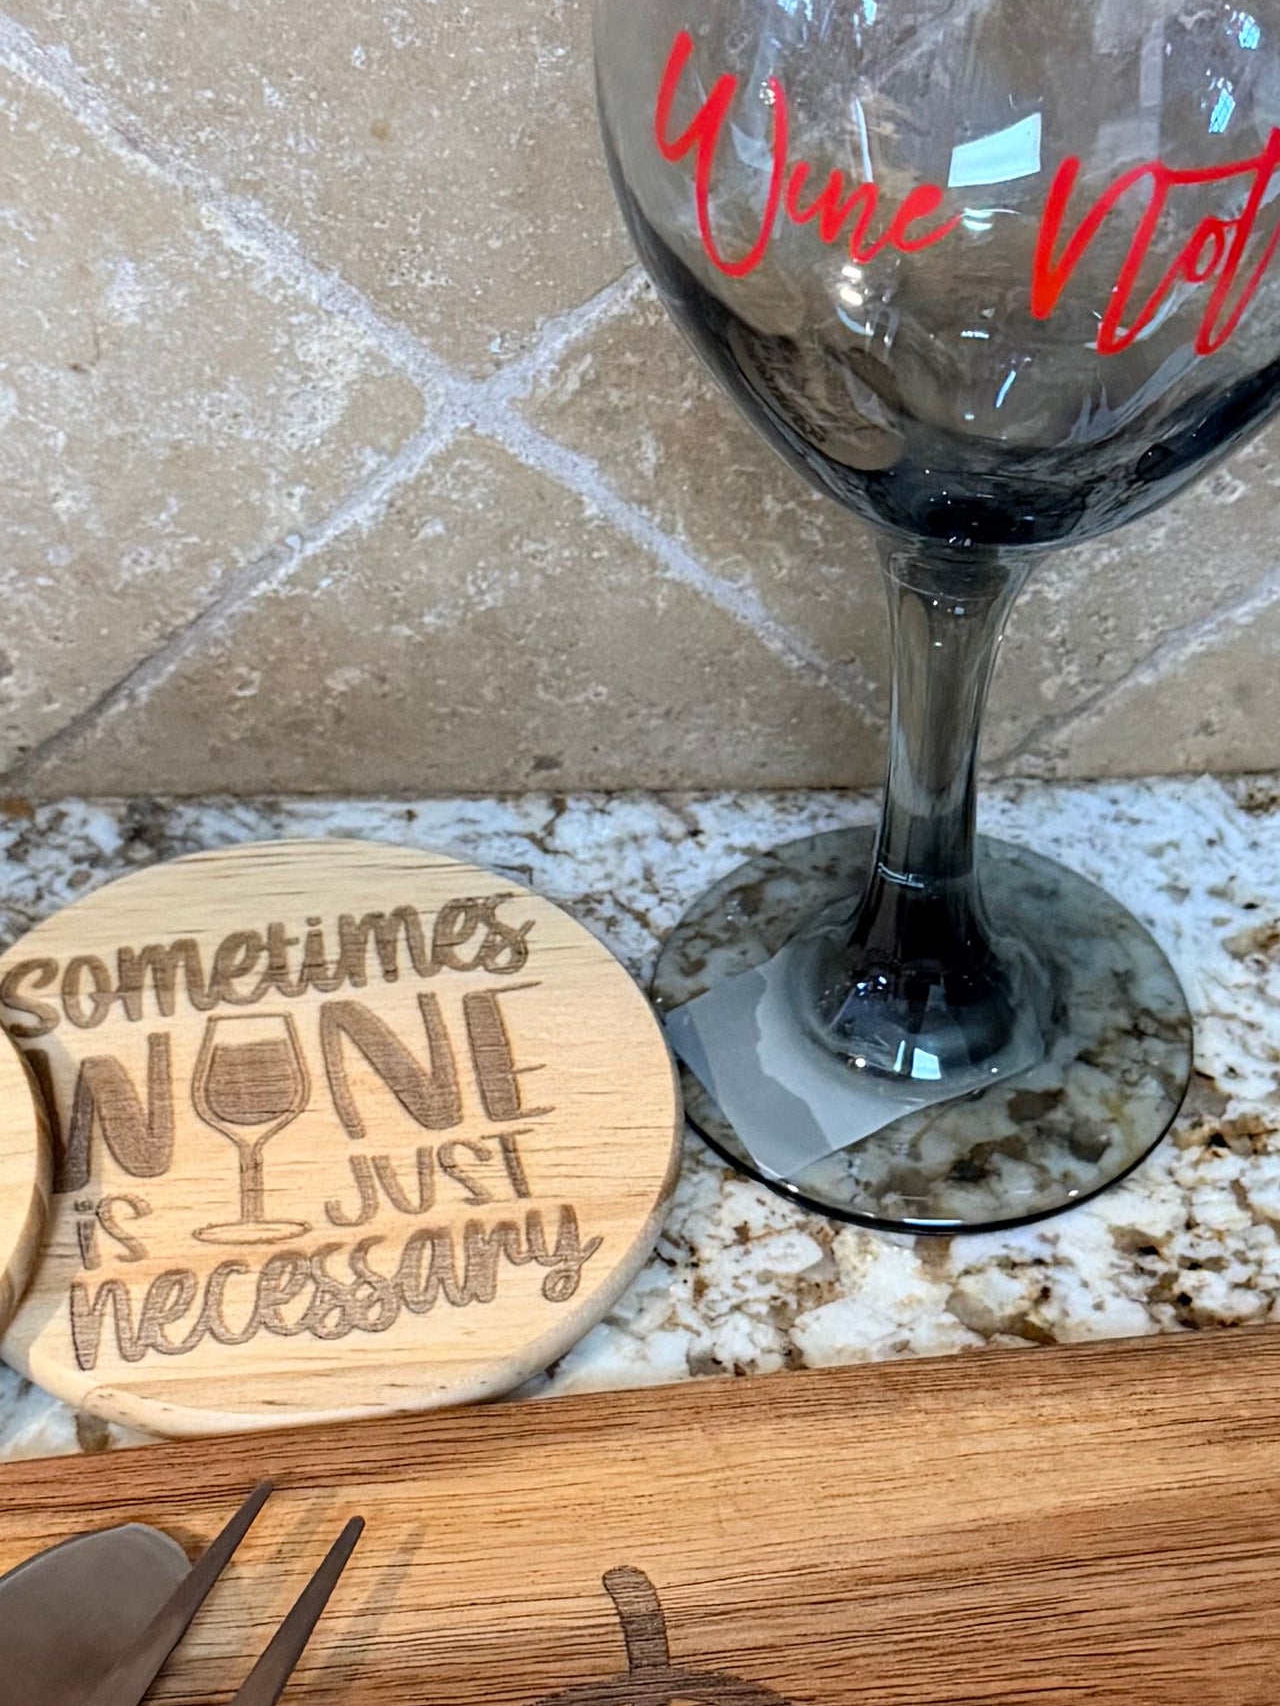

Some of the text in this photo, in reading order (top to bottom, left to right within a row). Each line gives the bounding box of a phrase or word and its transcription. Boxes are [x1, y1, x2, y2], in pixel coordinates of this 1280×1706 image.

[654, 31, 962, 277] Wine
[324, 1129, 534, 1227] JUST
[70, 1203, 604, 1373] necessary
